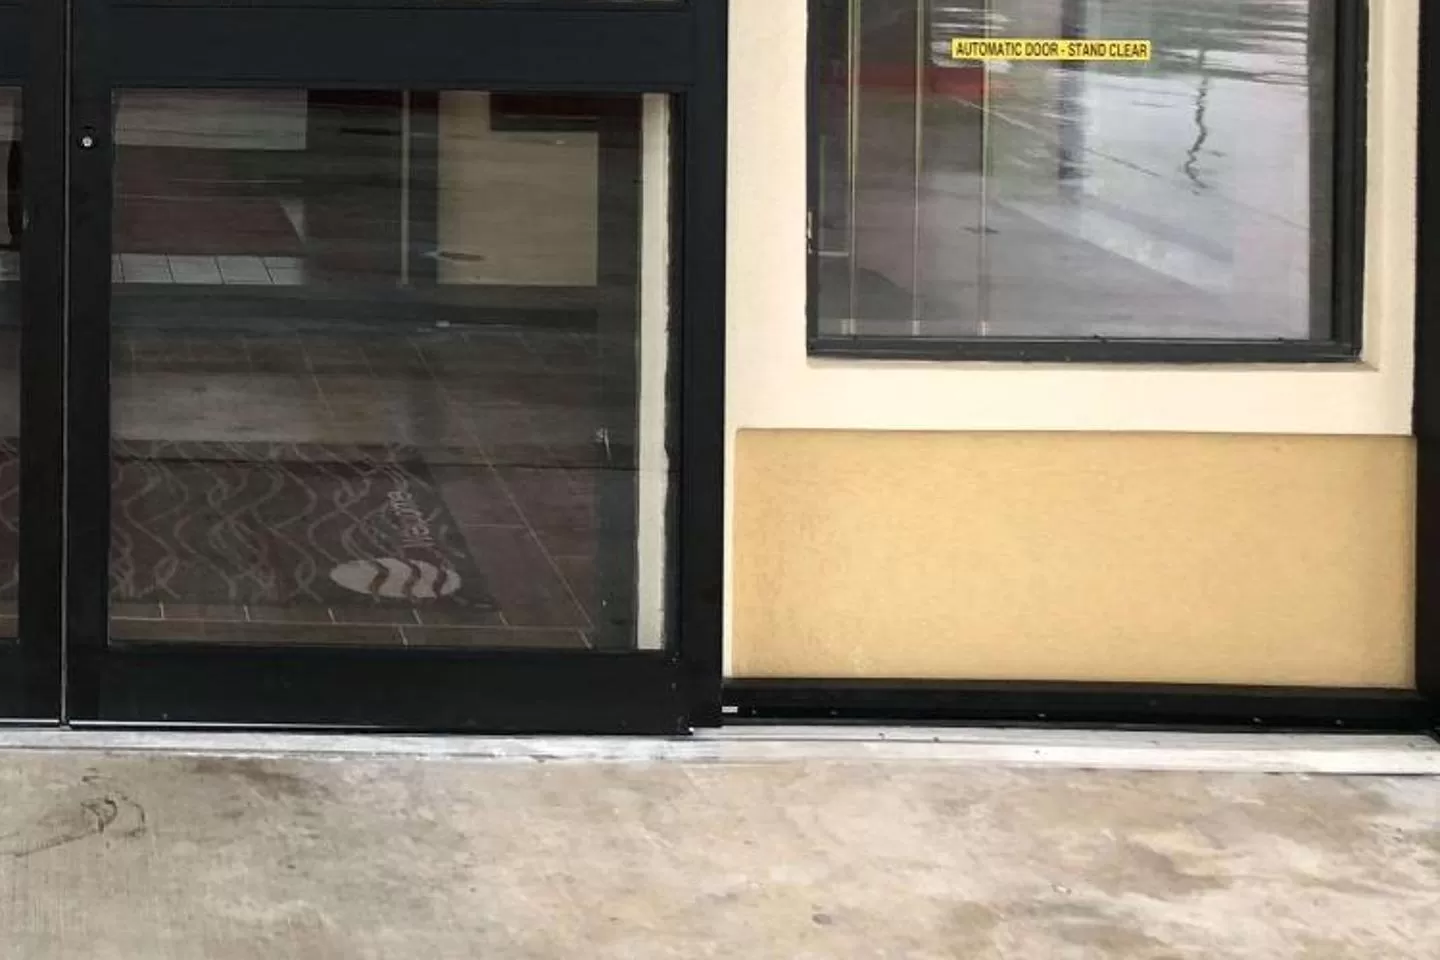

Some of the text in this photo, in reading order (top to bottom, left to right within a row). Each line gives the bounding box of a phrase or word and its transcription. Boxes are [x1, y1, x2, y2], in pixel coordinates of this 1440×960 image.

[956, 42, 1022, 57] AUTOMATIC
[1025, 42, 1059, 57] DOOR
[1068, 43, 1106, 57] STAND
[1110, 43, 1148, 57] CLEAR
